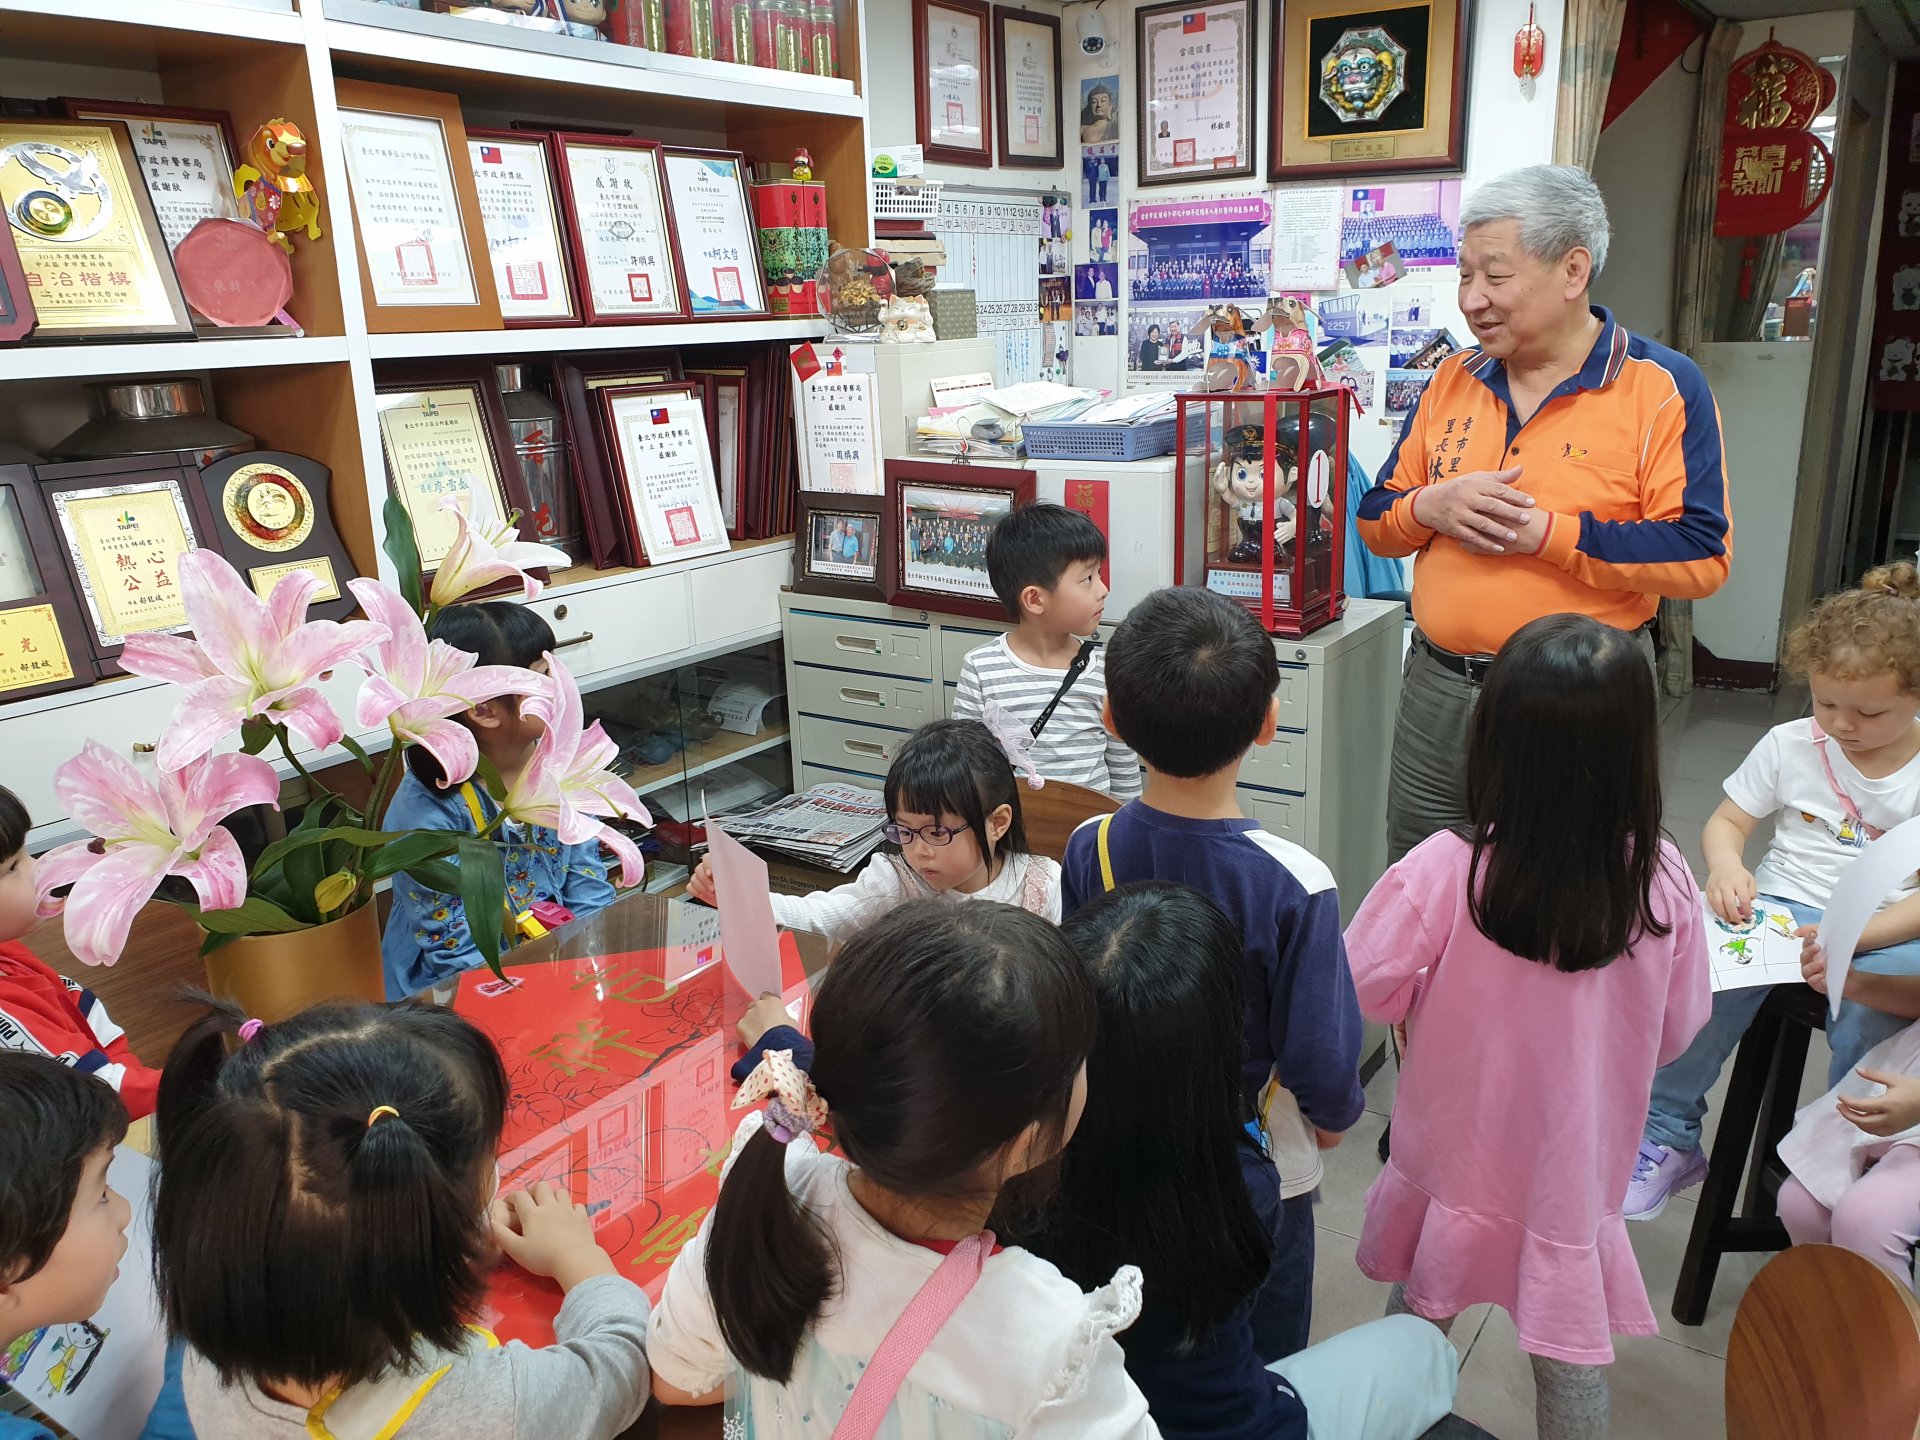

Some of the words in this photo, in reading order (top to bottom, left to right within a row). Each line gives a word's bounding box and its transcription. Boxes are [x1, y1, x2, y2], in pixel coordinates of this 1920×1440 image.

[142, 137, 167, 146] TAIPEI
[946, 204, 951, 214] 4
[954, 204, 959, 214] 5
[962, 204, 968, 215] 6
[971, 205, 976, 215] 7
[979, 205, 984, 216] 8
[987, 206, 992, 216] 9
[994, 206, 1001, 216] 10
[1002, 207, 1009, 217] 11
[1009, 207, 1017, 217] 12
[1017, 208, 1024, 218] 13
[1025, 208, 1032, 218] 14
[1032, 208, 1039, 219] 15
[25, 271, 132, 287] 自治楷模
[980, 304, 988, 315] 24
[987, 304, 996, 314] 25
[995, 304, 1003, 314] 26
[1003, 303, 1011, 314] 27
[1010, 303, 1018, 313] 28
[1018, 303, 1026, 313] 29
[1026, 303, 1033, 312] 30
[1327, 321, 1351, 331] 2257
[117, 523, 139, 531] TAIPEI
[115, 550, 166, 571] 熱心
[123, 568, 173, 591] 公益
